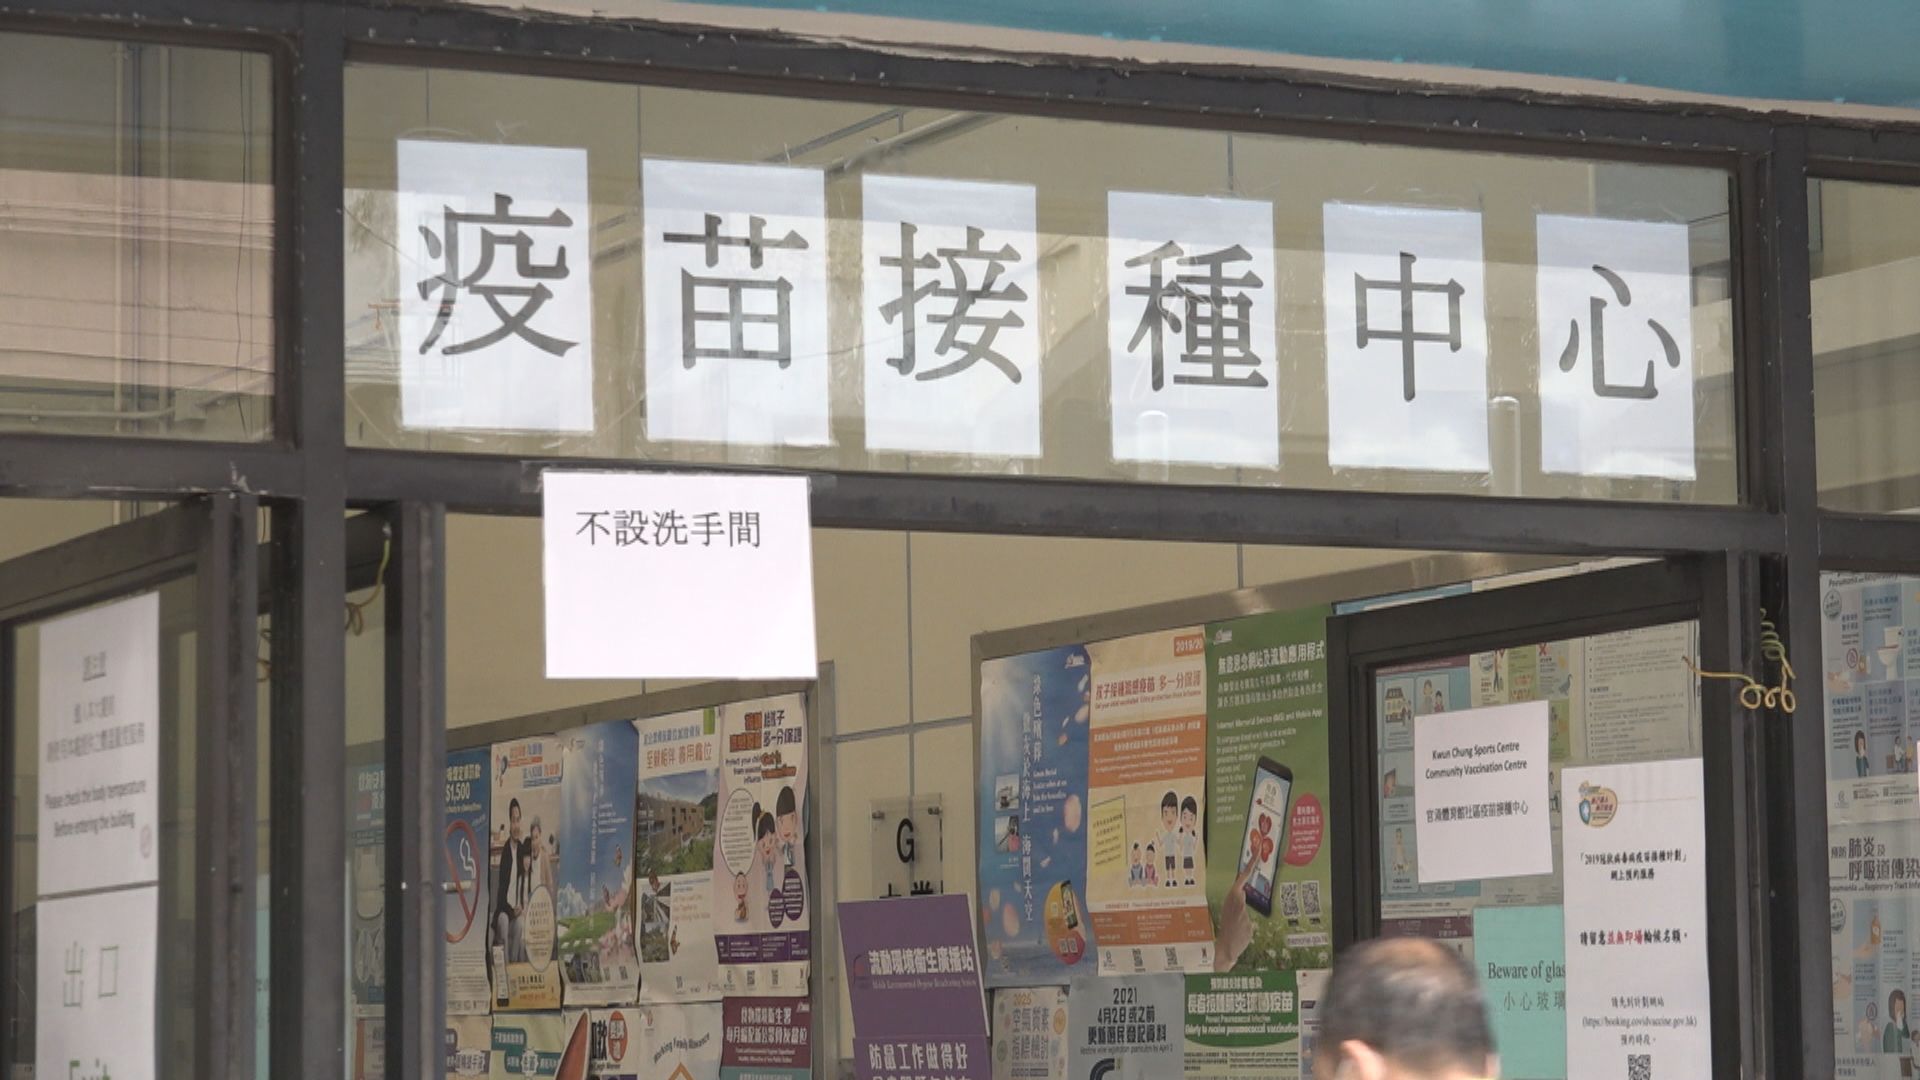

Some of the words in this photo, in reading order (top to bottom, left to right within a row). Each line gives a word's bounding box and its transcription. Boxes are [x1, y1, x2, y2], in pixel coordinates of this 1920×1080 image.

[418, 192, 1681, 401] 疫苗接種中心
[576, 509, 760, 548] 不設洗手間
[1432, 748, 1451, 760] Kwun
[1451, 746, 1473, 759] Chung
[1473, 743, 1496, 756] Sports
[1497, 741, 1520, 754] Centre
[1425, 764, 1463, 780] Community
[1463, 762, 1503, 776] Vaccination
[1504, 759, 1527, 772] Centre
[896, 818, 915, 863] G
[1488, 961, 1528, 980] Beware
[1531, 961, 1544, 979] of
[1545, 961, 1566, 983] glas
[1113, 987, 1139, 1004] 2021
